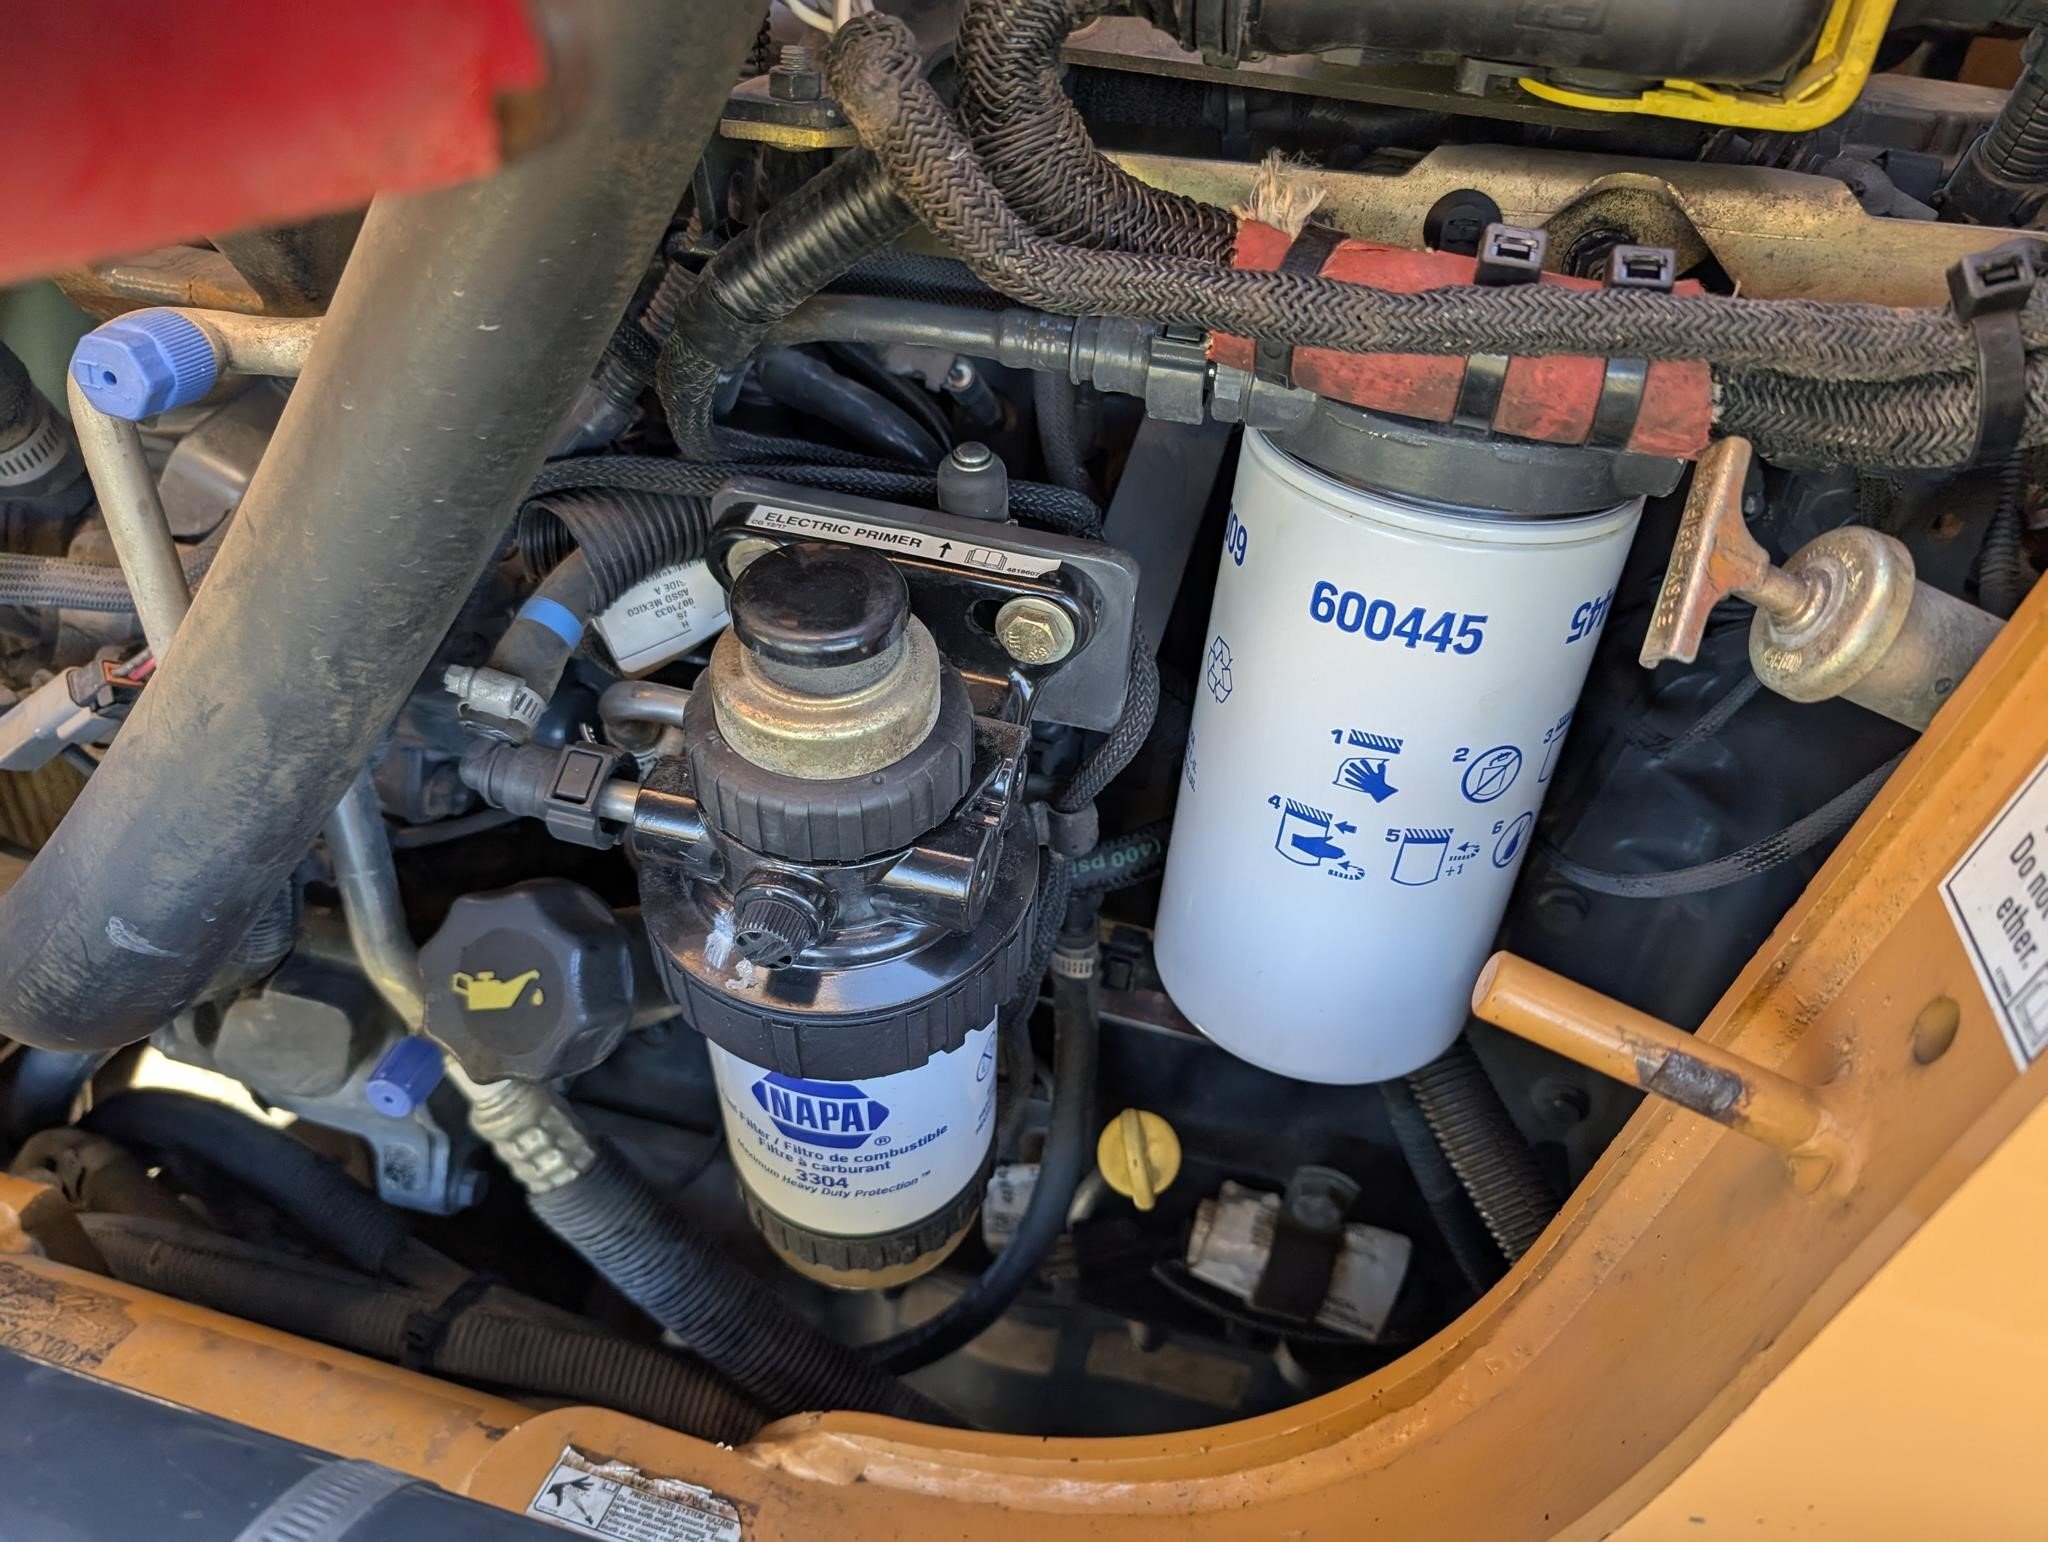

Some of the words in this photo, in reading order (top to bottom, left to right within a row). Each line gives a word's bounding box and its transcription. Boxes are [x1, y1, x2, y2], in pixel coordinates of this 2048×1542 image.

[765, 512, 851, 535] ELECTRIC
[854, 528, 922, 548] PRIMER
[653, 586, 662, 595] A
[627, 598, 663, 617] MEXICO
[1310, 580, 1488, 655] 600445
[1331, 729, 1343, 744] 1
[1543, 729, 1553, 744] 3
[1452, 748, 1469, 762] 2
[1267, 795, 1281, 809] 4
[1385, 829, 1400, 842] 5
[1491, 821, 1504, 835] 6
[1072, 853, 1105, 878] psi
[2010, 832, 2036, 879] Do
[1996, 896, 2038, 970] ether.
[770, 1086, 865, 1132] NAPA
[739, 1111, 771, 1140] Filter
[784, 1141, 824, 1160] Filtro
[829, 1153, 849, 1163] de
[854, 1124, 948, 1163] combustible
[758, 1136, 794, 1162] Filtre
[811, 1160, 891, 1174] carburant
[782, 1175, 818, 1194] Heavy
[821, 1187, 850, 1199] Duty
[854, 1177, 919, 1198] Protection
[795, 1168, 849, 1188] 3304
